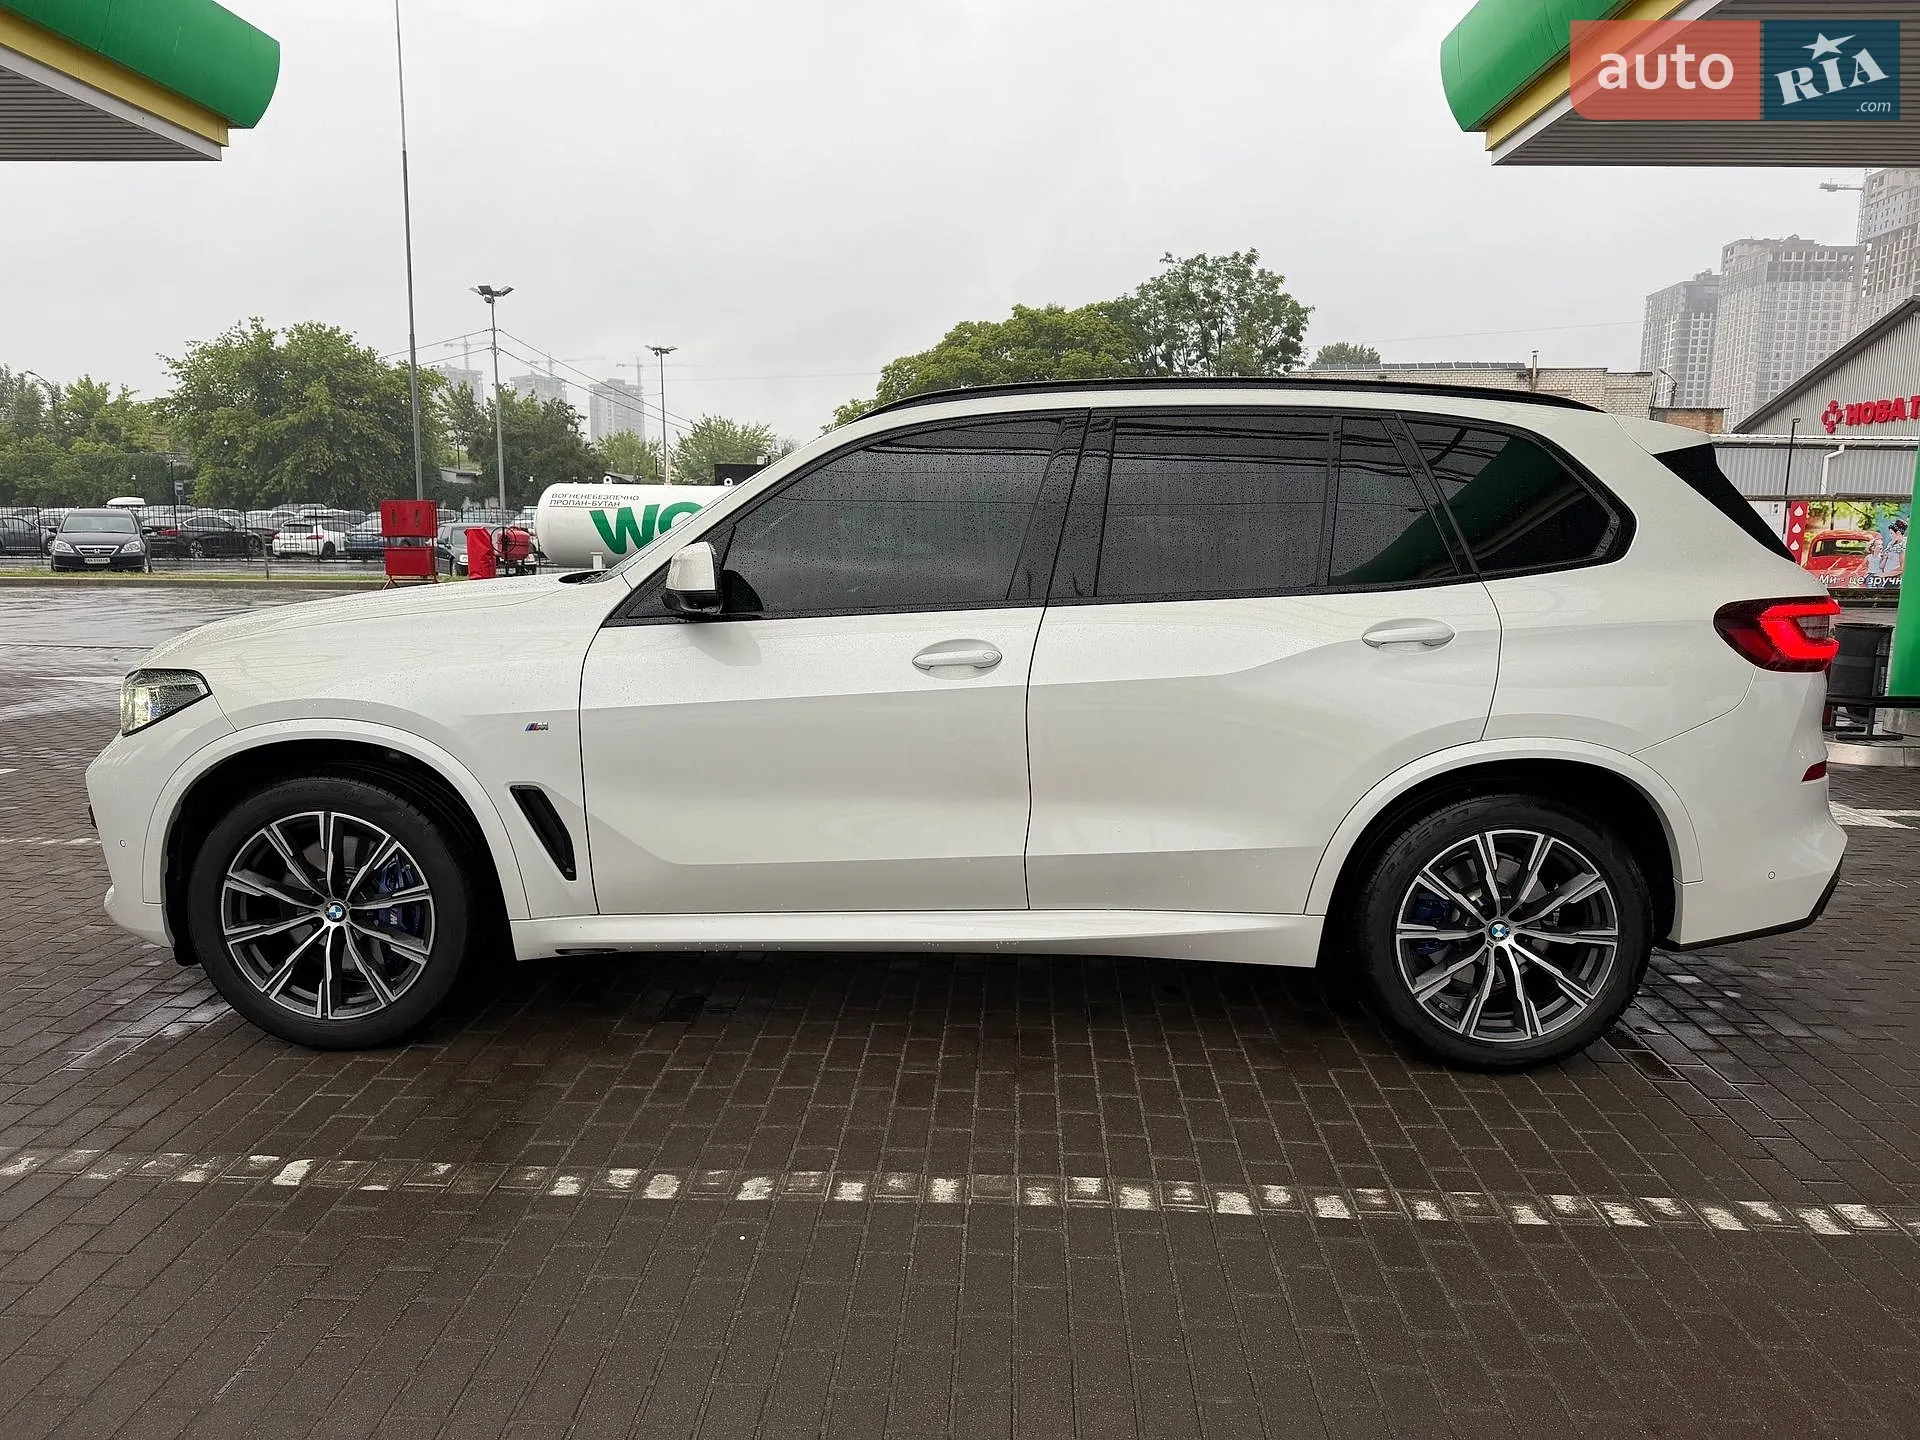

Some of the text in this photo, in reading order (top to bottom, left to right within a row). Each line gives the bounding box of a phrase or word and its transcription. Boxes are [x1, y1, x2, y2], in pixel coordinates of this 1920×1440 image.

[1845, 397, 1906, 426] НОВА
[549, 499, 621, 507] ПРОПАН-БУТАН
[1820, 574, 1837, 584] Ми
[1849, 575, 1865, 586] це
